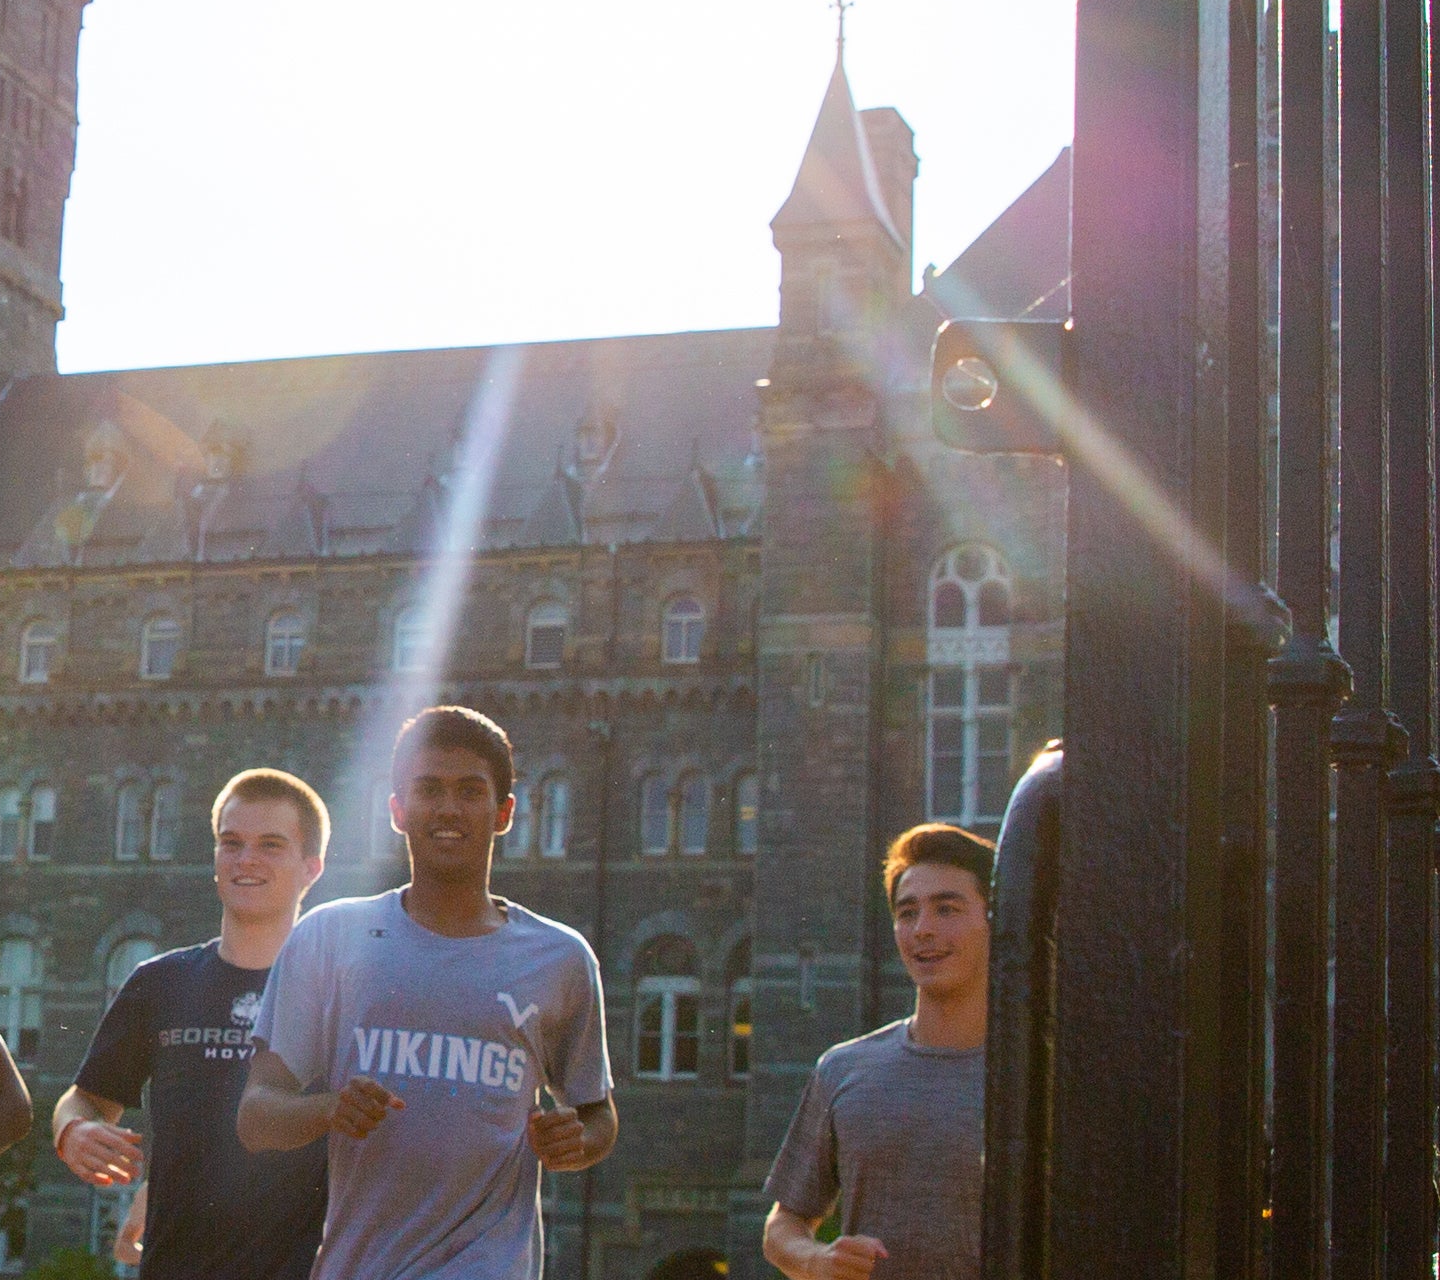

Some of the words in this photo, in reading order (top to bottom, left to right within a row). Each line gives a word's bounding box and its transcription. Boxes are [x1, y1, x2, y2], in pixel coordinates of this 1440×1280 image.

[159, 1027, 255, 1047] GEORGE
[204, 1046, 257, 1060] HOY
[353, 1026, 527, 1093] VIKINGS
